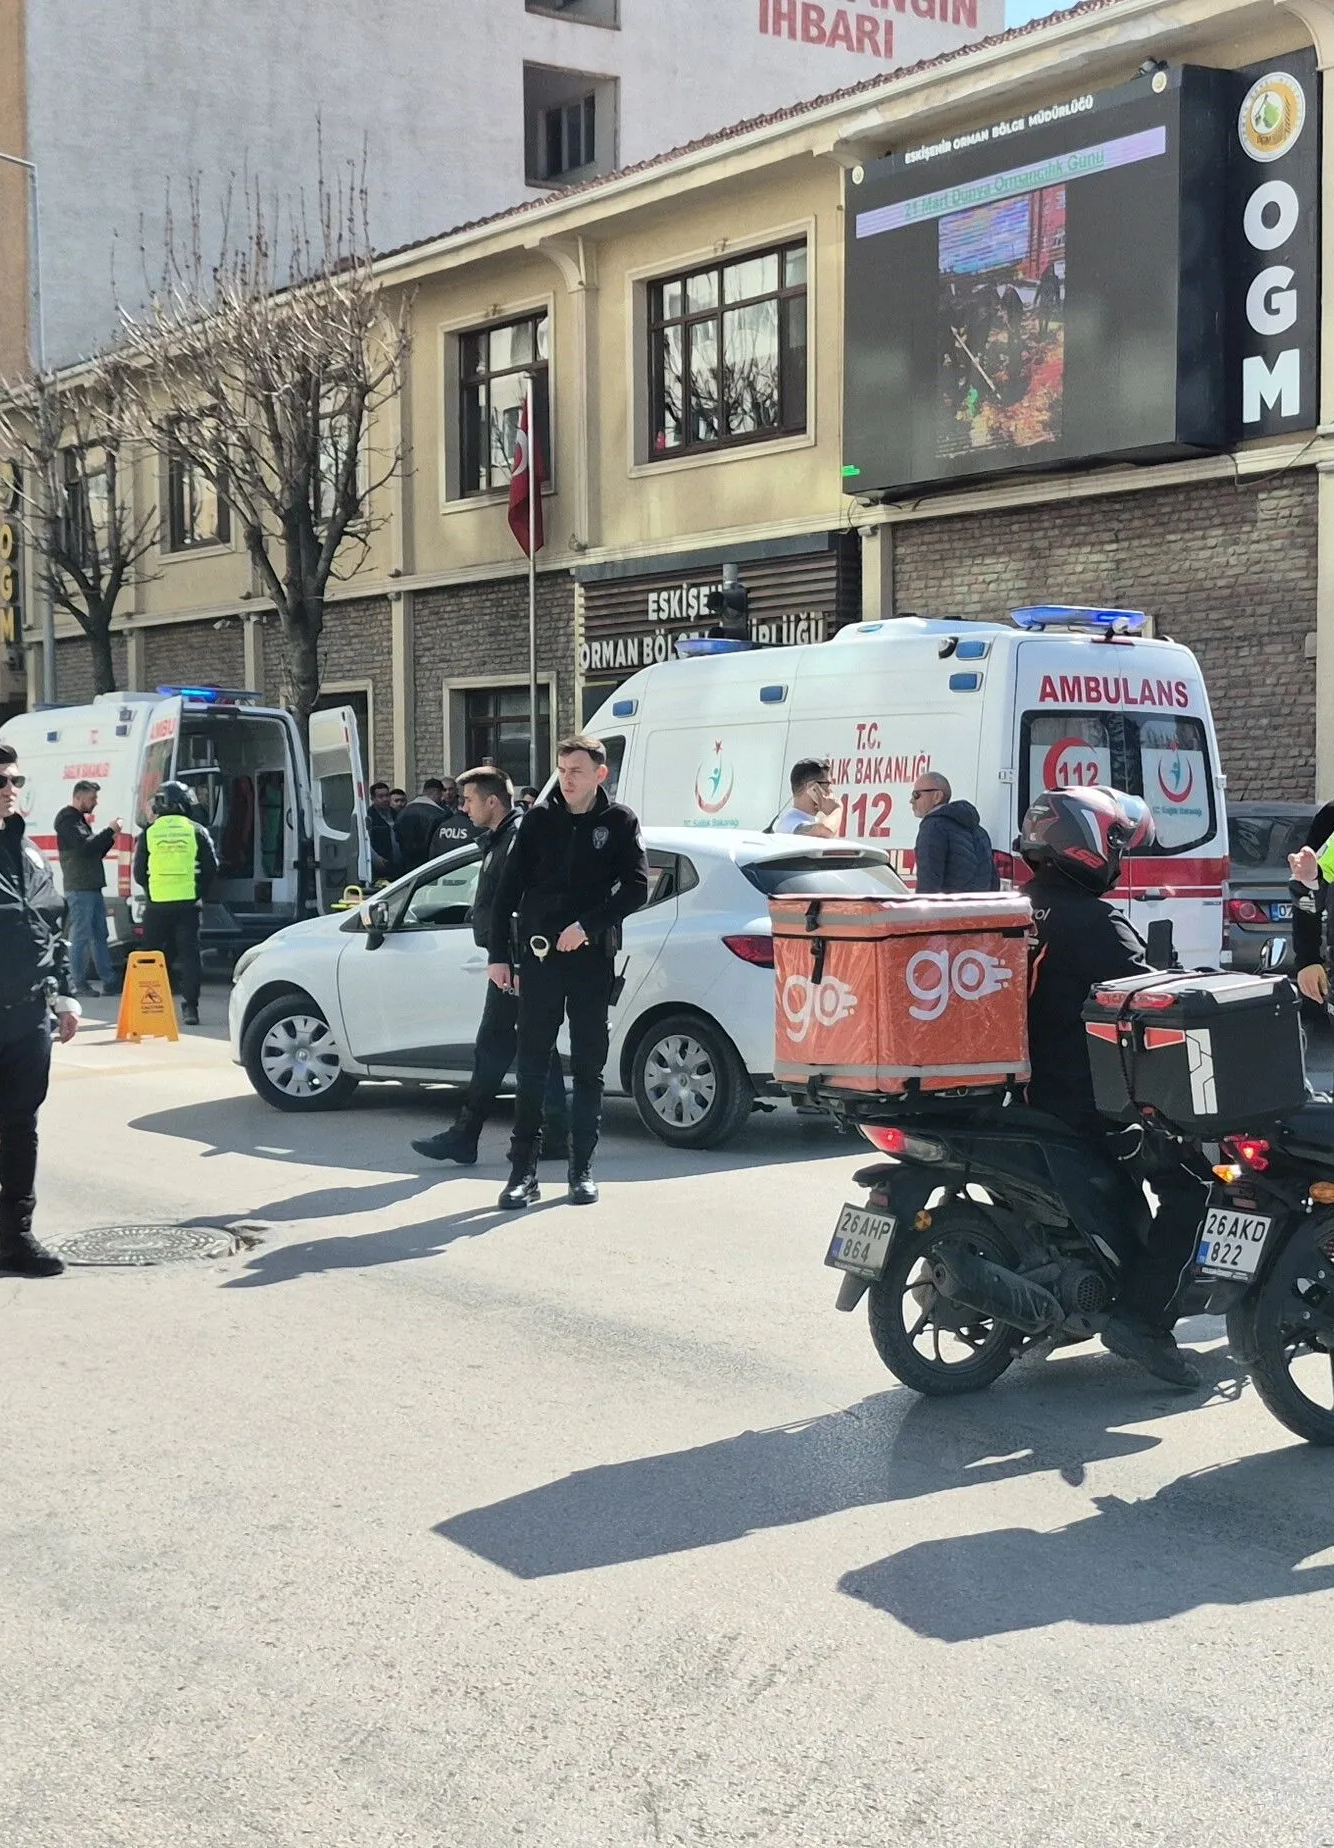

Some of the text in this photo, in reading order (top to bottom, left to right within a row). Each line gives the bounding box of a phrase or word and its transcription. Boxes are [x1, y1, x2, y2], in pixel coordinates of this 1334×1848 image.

[953, 129, 989, 150] ORMAN
[992, 118, 1025, 138] BÖLGE
[1243, 180, 1300, 424] OGM
[580, 637, 639, 670] ORMAN
[1038, 675, 1189, 708] AMBULANS
[855, 723, 881, 750] T.C.
[1058, 761, 1100, 787] 112
[838, 792, 893, 838] 112
[843, 1239, 871, 1262] 864
[1210, 1241, 1243, 1267] 822
